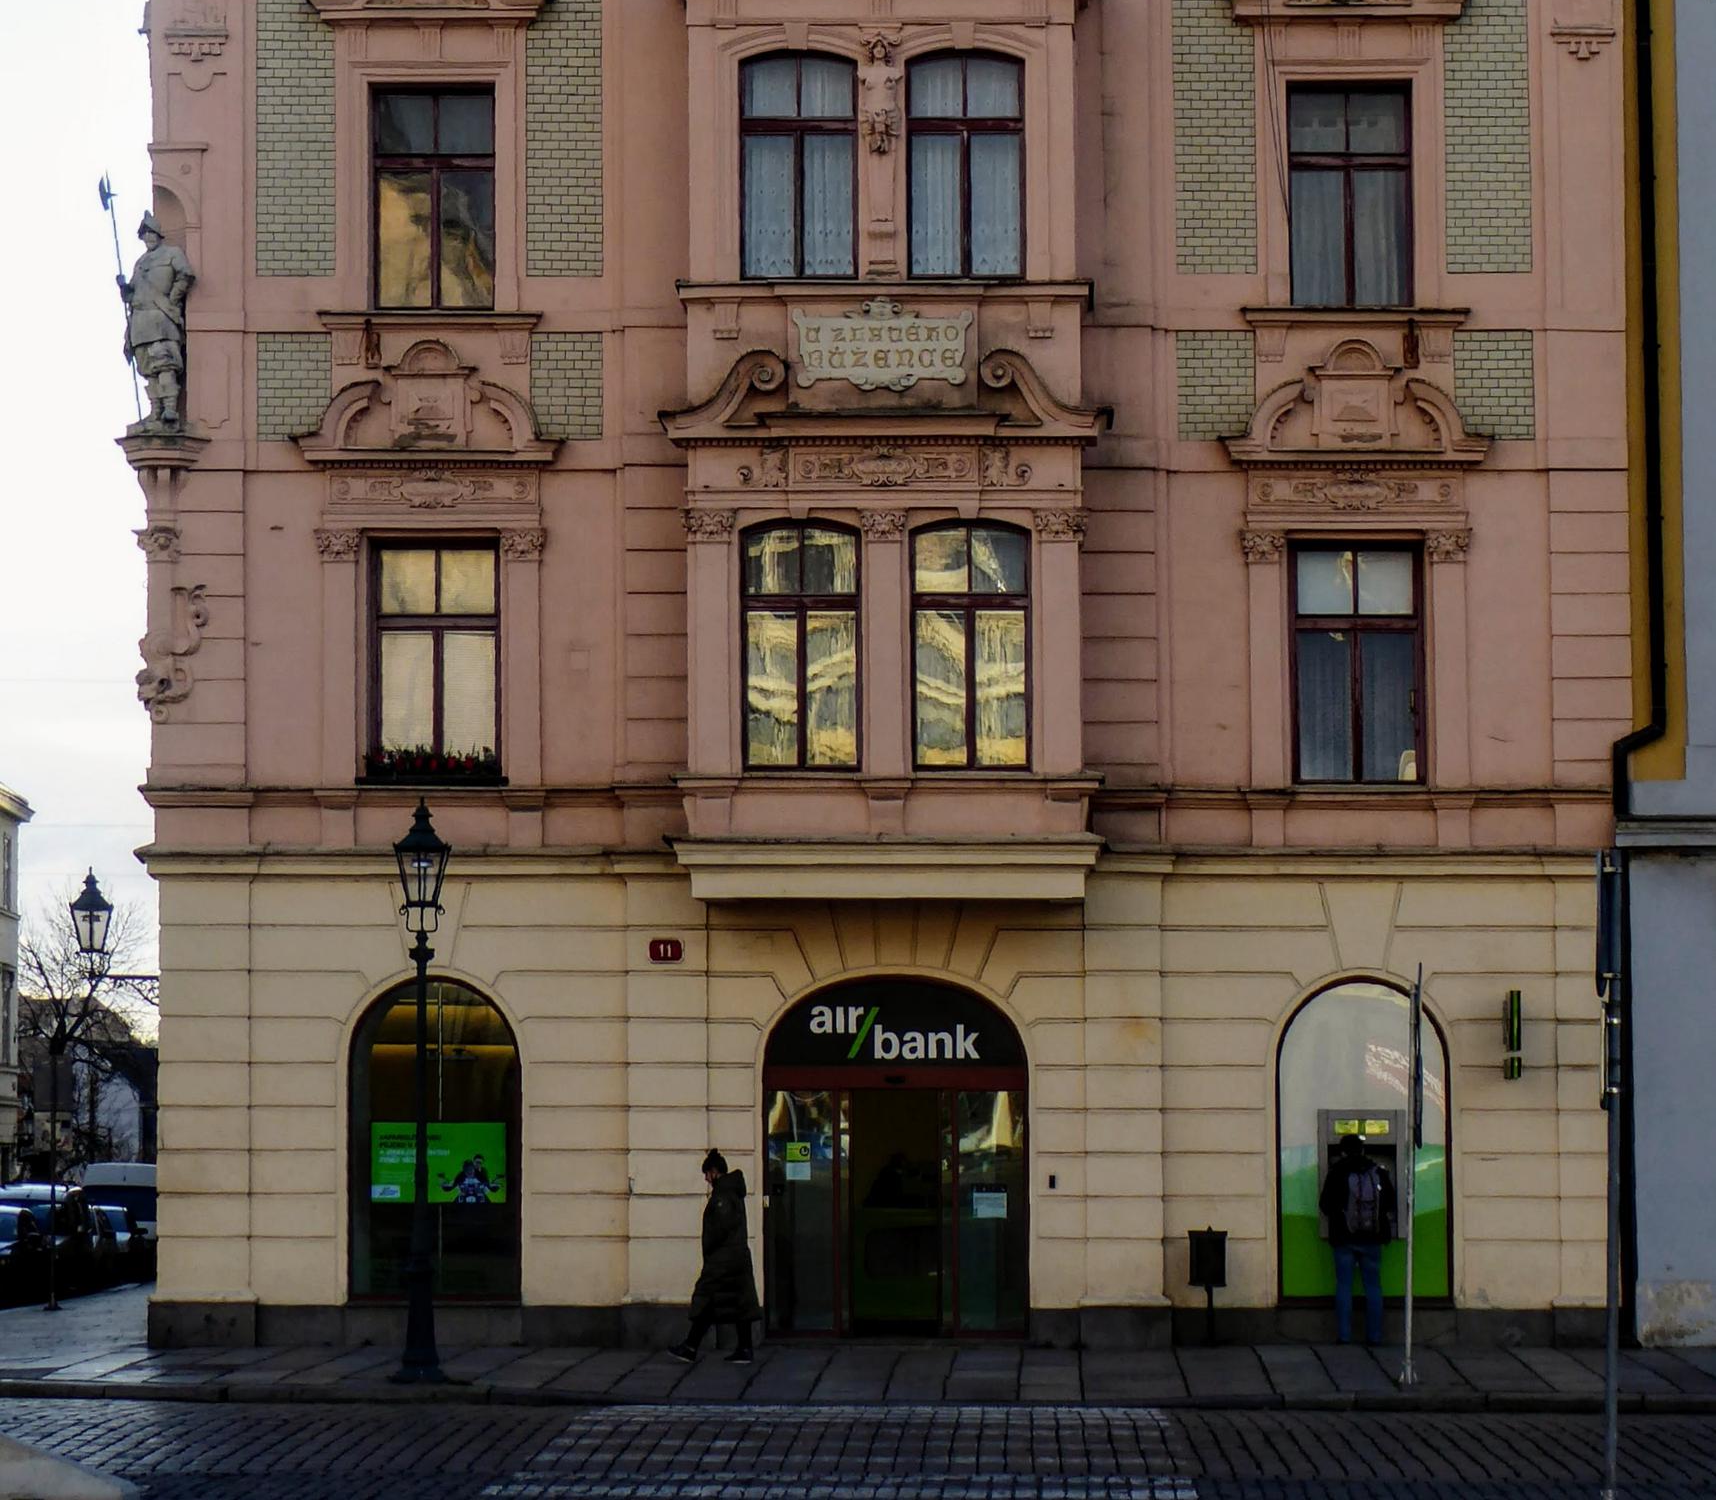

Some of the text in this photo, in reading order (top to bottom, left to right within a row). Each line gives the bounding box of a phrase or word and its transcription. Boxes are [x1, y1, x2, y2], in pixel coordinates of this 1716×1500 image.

[805, 326, 821, 344] U
[659, 943, 672, 958] 11
[873, 1024, 981, 1060] bank
